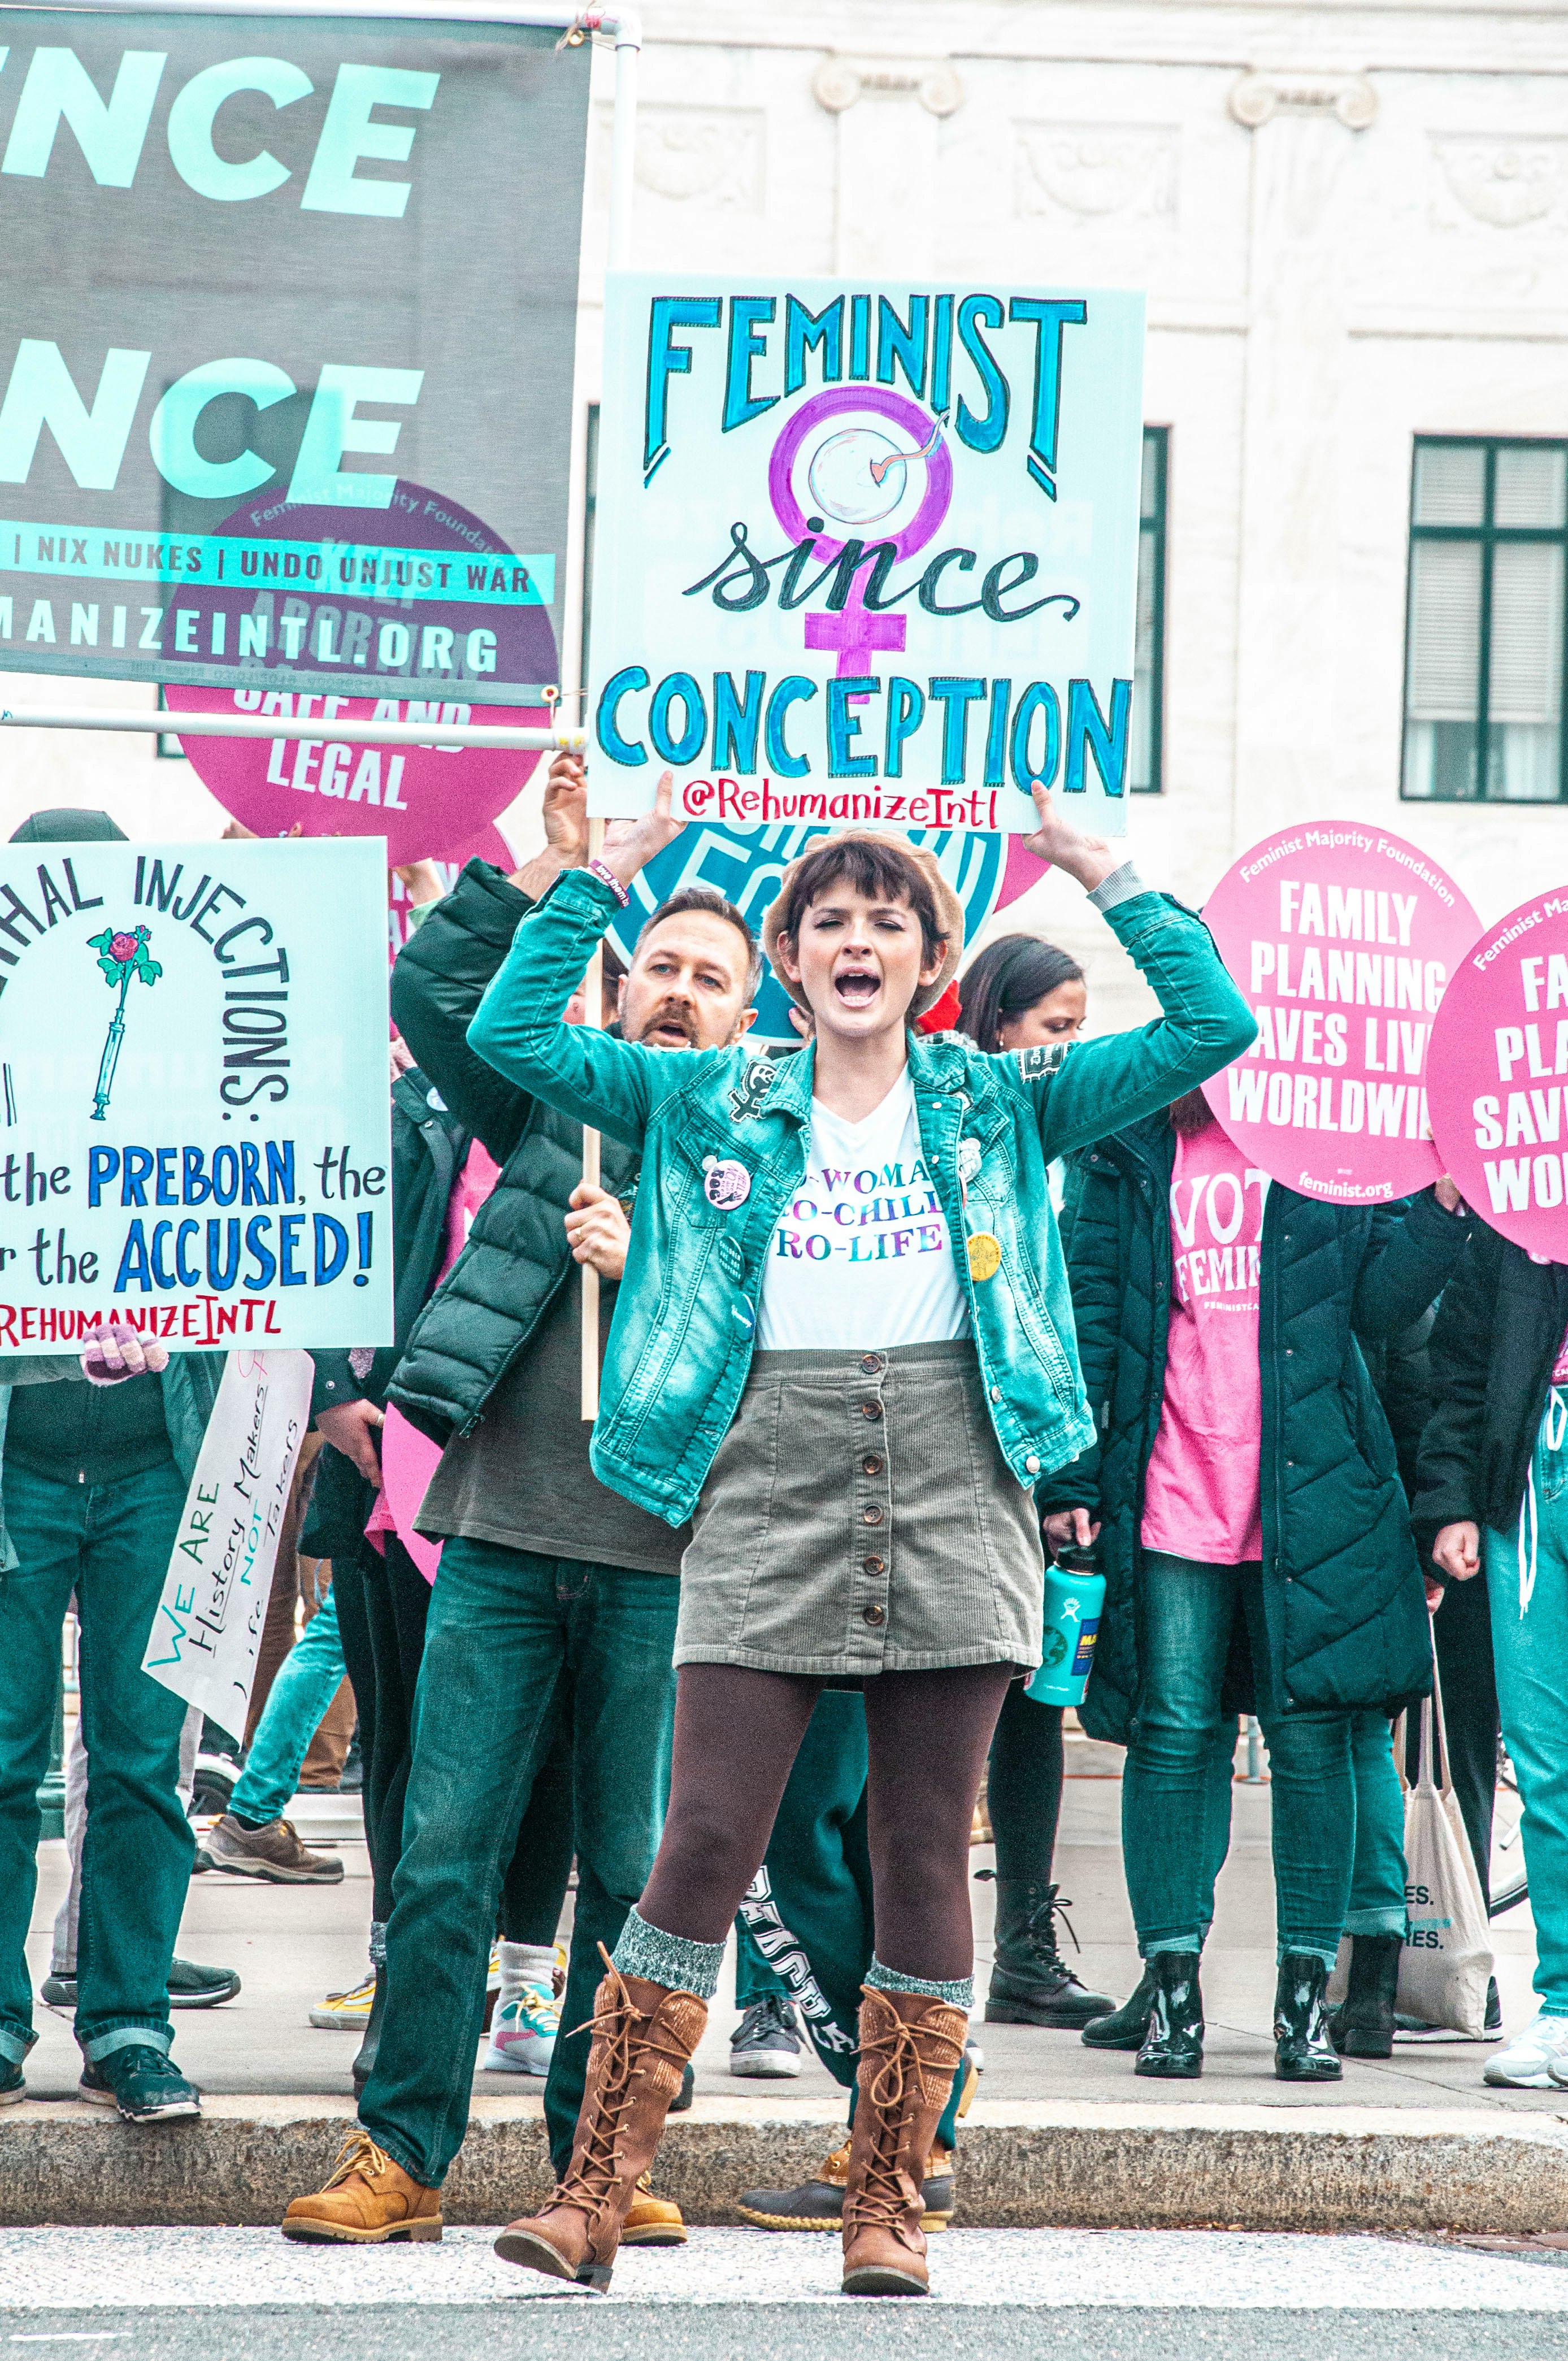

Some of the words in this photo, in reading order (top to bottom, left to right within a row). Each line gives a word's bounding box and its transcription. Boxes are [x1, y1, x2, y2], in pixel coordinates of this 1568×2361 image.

[0, 46, 440, 218] NCE
[0, 338, 424, 509] NCE
[644, 293, 1088, 502] FEMINIST
[37, 536, 88, 565] NIX
[103, 541, 202, 572] NUKES
[241, 550, 322, 580] UNDO
[340, 557, 451, 588] UNJUST
[467, 565, 530, 592] WAR
[682, 516, 1080, 622] since
[596, 666, 1133, 797] CONCEPTION
[266, 738, 408, 810] LEGAL
[682, 778, 999, 829] @RehumanizeIntl
[596, 864, 612, 879] love
[1239, 837, 1304, 883] Feminist
[1305, 830, 1374, 853] Majority
[1376, 838, 1455, 908] Foundation
[1279, 880, 1418, 947] FAMILY
[1473, 910, 1543, 971] Feminist
[134, 856, 290, 1122] INJECTIONS:
[1250, 941, 1446, 1014] PLANNING
[1365, 1017, 1432, 1075] LIV
[1473, 1087, 1568, 1150] SAV
[0, 1152, 71, 1206] the
[88, 1139, 307, 1208] PREBORN,
[314, 1145, 386, 1200] the
[799, 1160, 932, 1193] -WOMA
[1298, 1171, 1394, 1199] feminist.org
[1483, 1152, 1568, 1214] WO
[28, 1228, 99, 1285] the
[114, 1211, 375, 1292] ACCUSED!
[188, 1518, 246, 1659] History
[233, 1385, 267, 1501] Makers
[241, 1499, 262, 1586] NOT
[147, 1583, 195, 1668] WE
[179, 1482, 219, 1564] ARE
